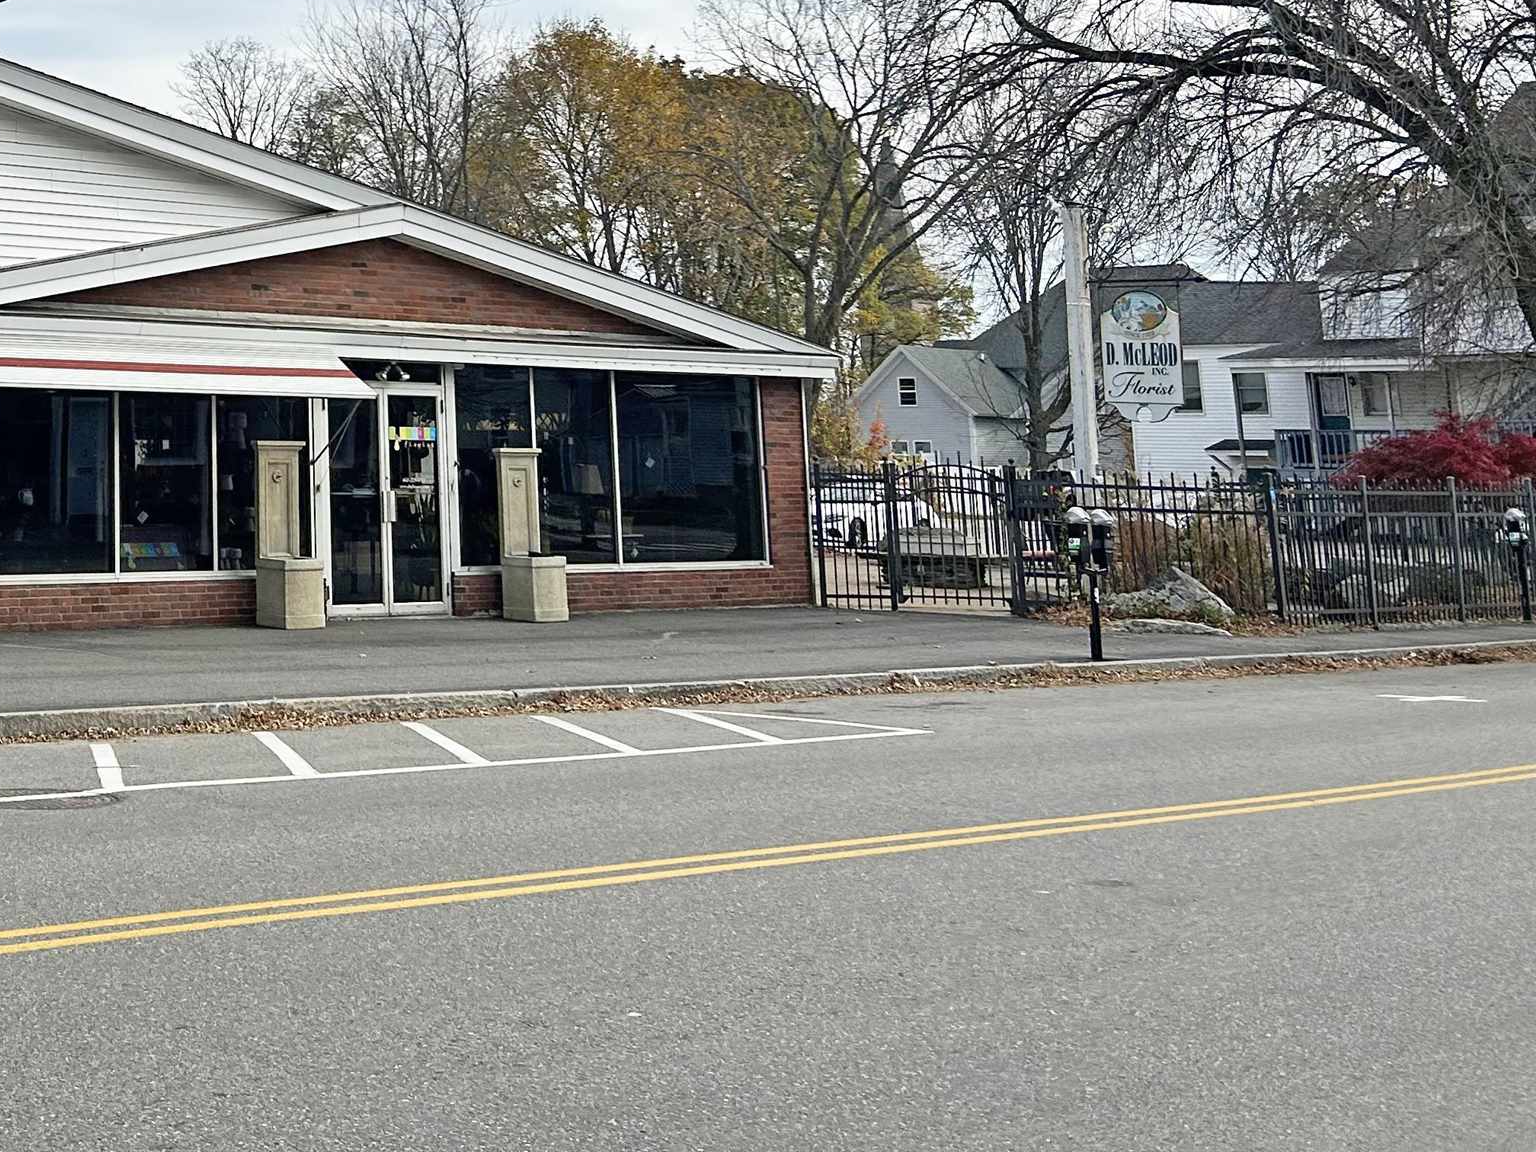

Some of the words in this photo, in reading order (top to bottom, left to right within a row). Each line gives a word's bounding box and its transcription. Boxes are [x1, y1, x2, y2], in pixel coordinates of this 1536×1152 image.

[1105, 342, 1119, 366] D.
[1123, 342, 1178, 366] McLEOD
[1151, 368, 1169, 376] INC.
[1108, 371, 1175, 398] Florist
